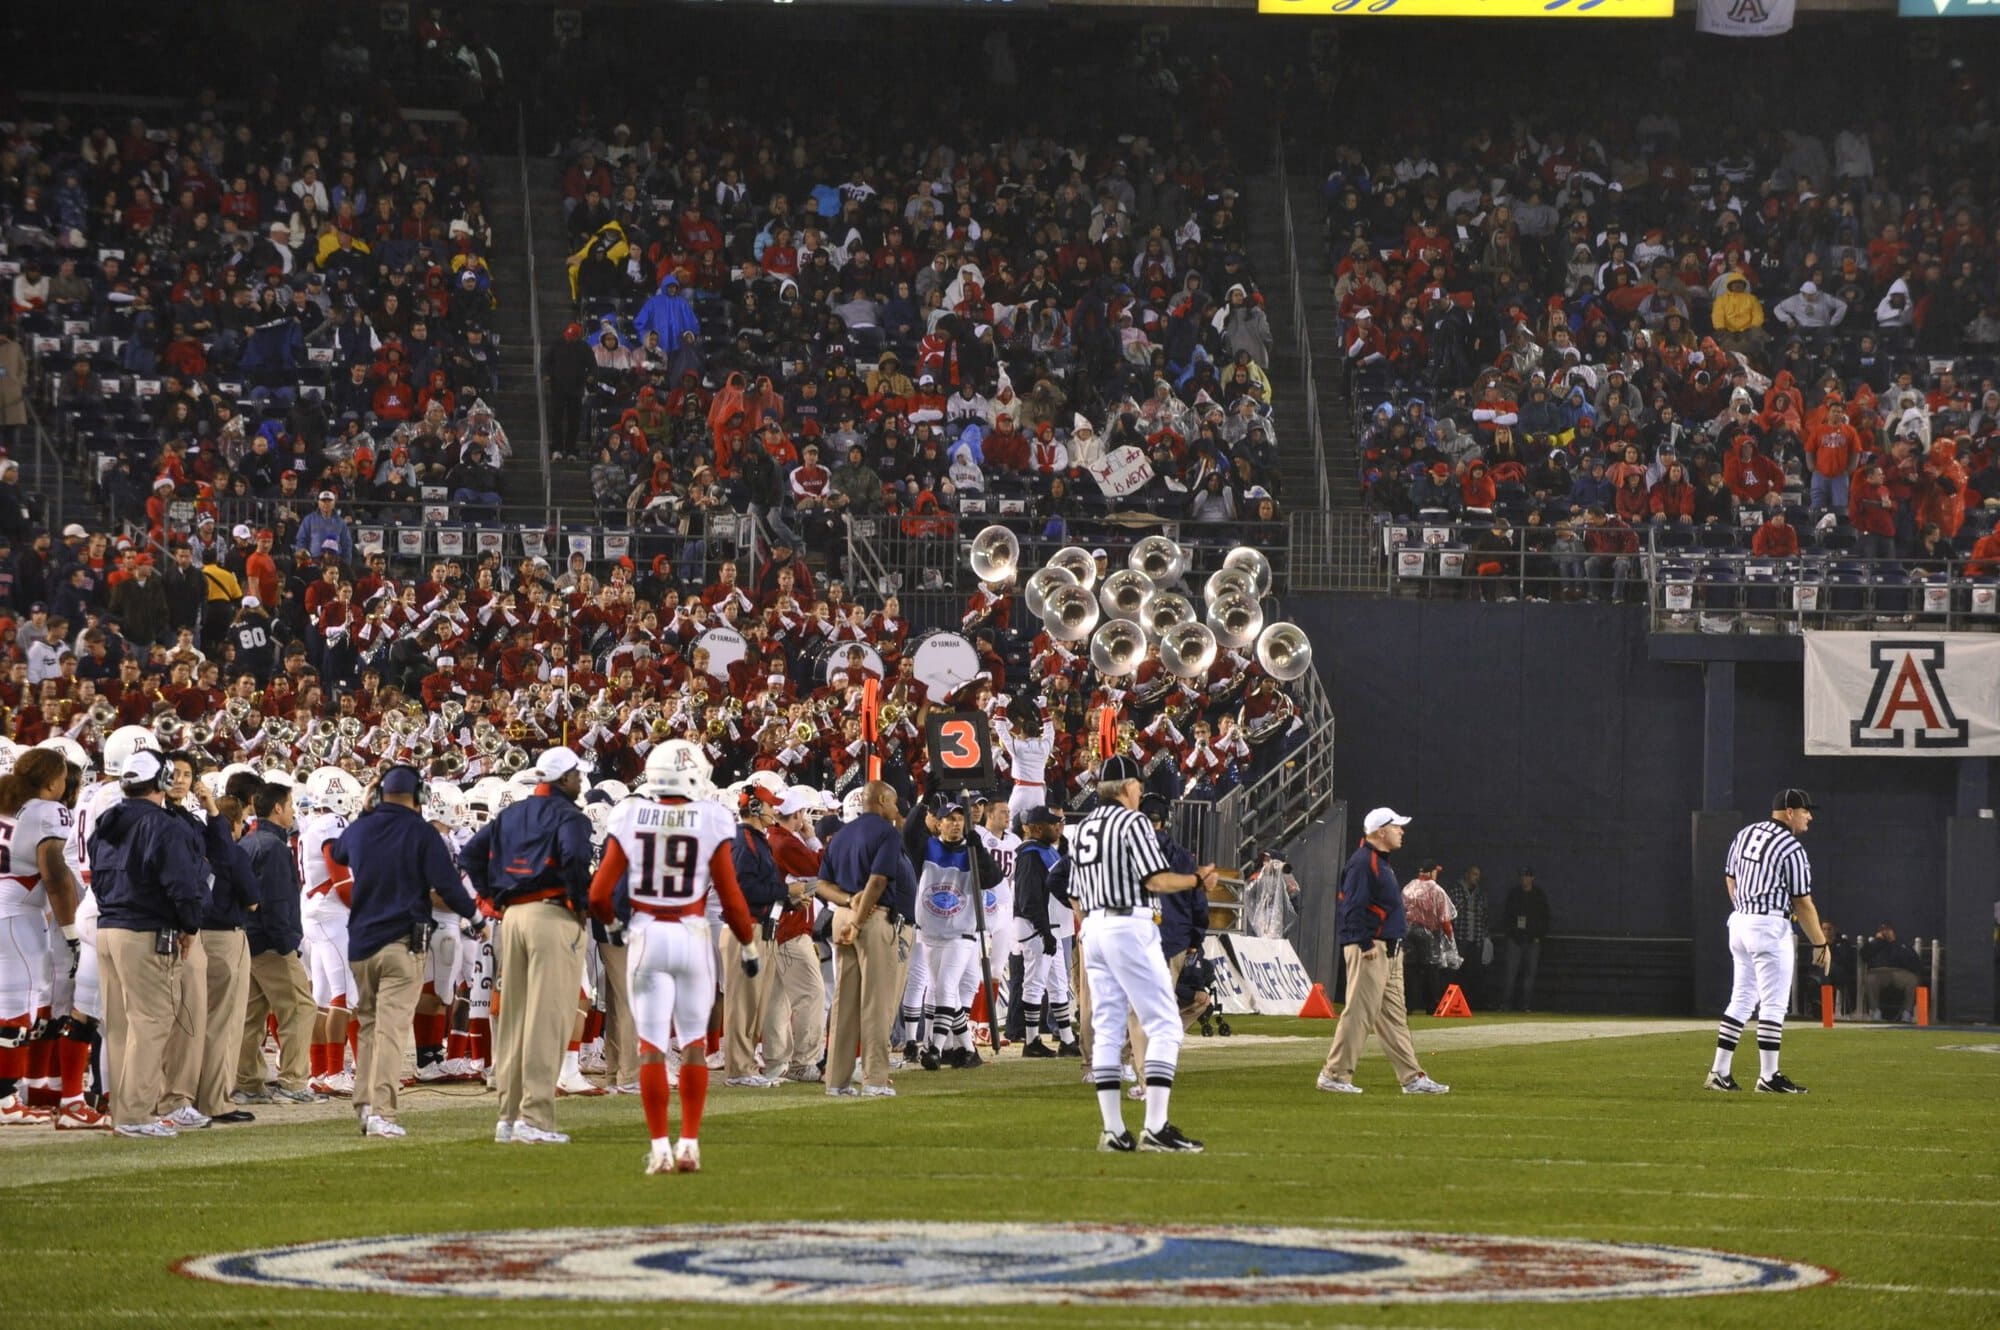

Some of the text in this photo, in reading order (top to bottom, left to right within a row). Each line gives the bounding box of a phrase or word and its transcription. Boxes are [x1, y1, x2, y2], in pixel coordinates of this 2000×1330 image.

[1125, 463, 1149, 489] NEXT
[239, 626, 267, 650] 90
[716, 634, 740, 645] YAMAHA
[937, 640, 960, 648] YAMAHA
[1849, 640, 1969, 749] A
[941, 720, 981, 769] 3
[325, 777, 346, 795] A
[637, 807, 699, 828] WRIGHT
[1078, 818, 1103, 865] S
[1743, 828, 1773, 863] H
[634, 831, 699, 898] 19
